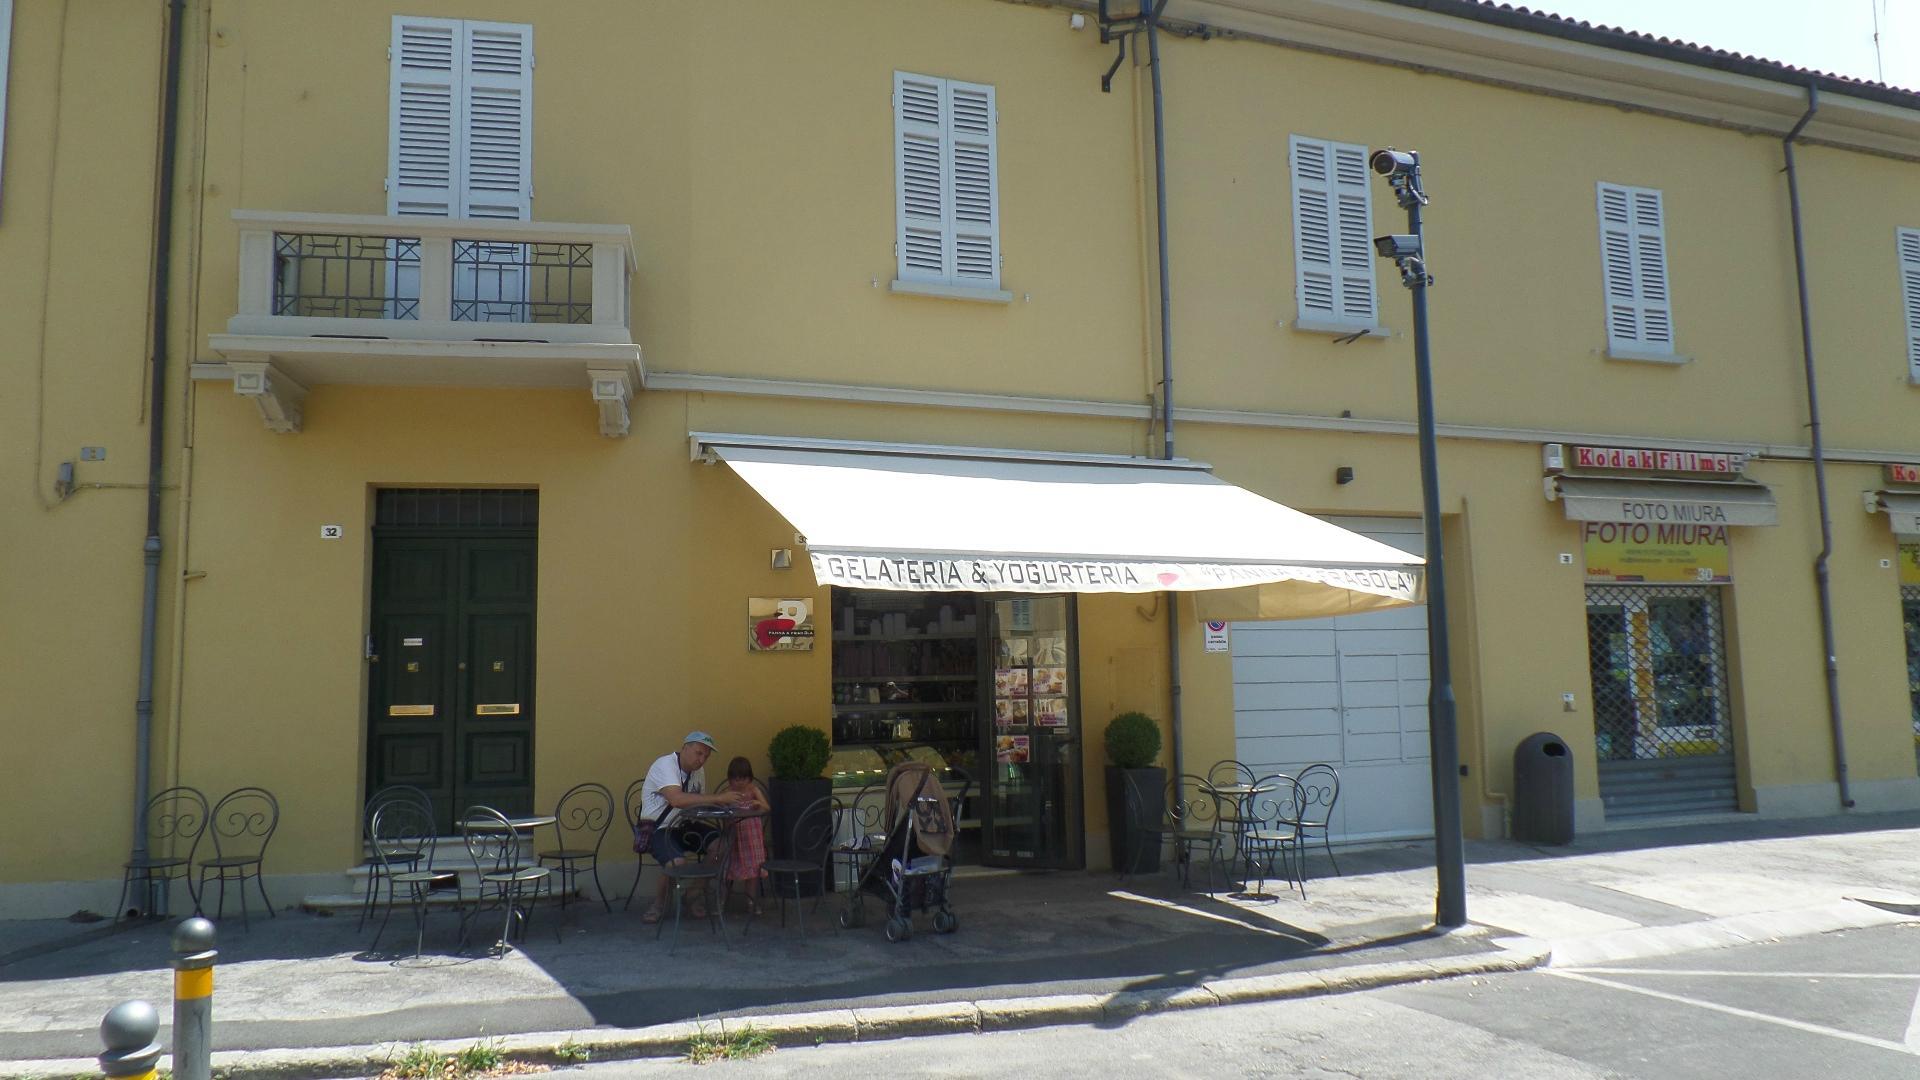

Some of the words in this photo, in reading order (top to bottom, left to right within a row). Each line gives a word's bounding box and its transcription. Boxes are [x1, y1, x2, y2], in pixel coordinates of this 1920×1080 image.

[1622, 502, 1668, 520] FOTO
[1673, 505, 1727, 522] MIURA
[325, 527, 336, 537] 32
[1584, 522, 1649, 544] FOTO
[1657, 525, 1728, 546] MIURA
[828, 557, 963, 584] GELATERIA
[972, 562, 988, 584] &
[994, 562, 1139, 585] YOGURTERIA
